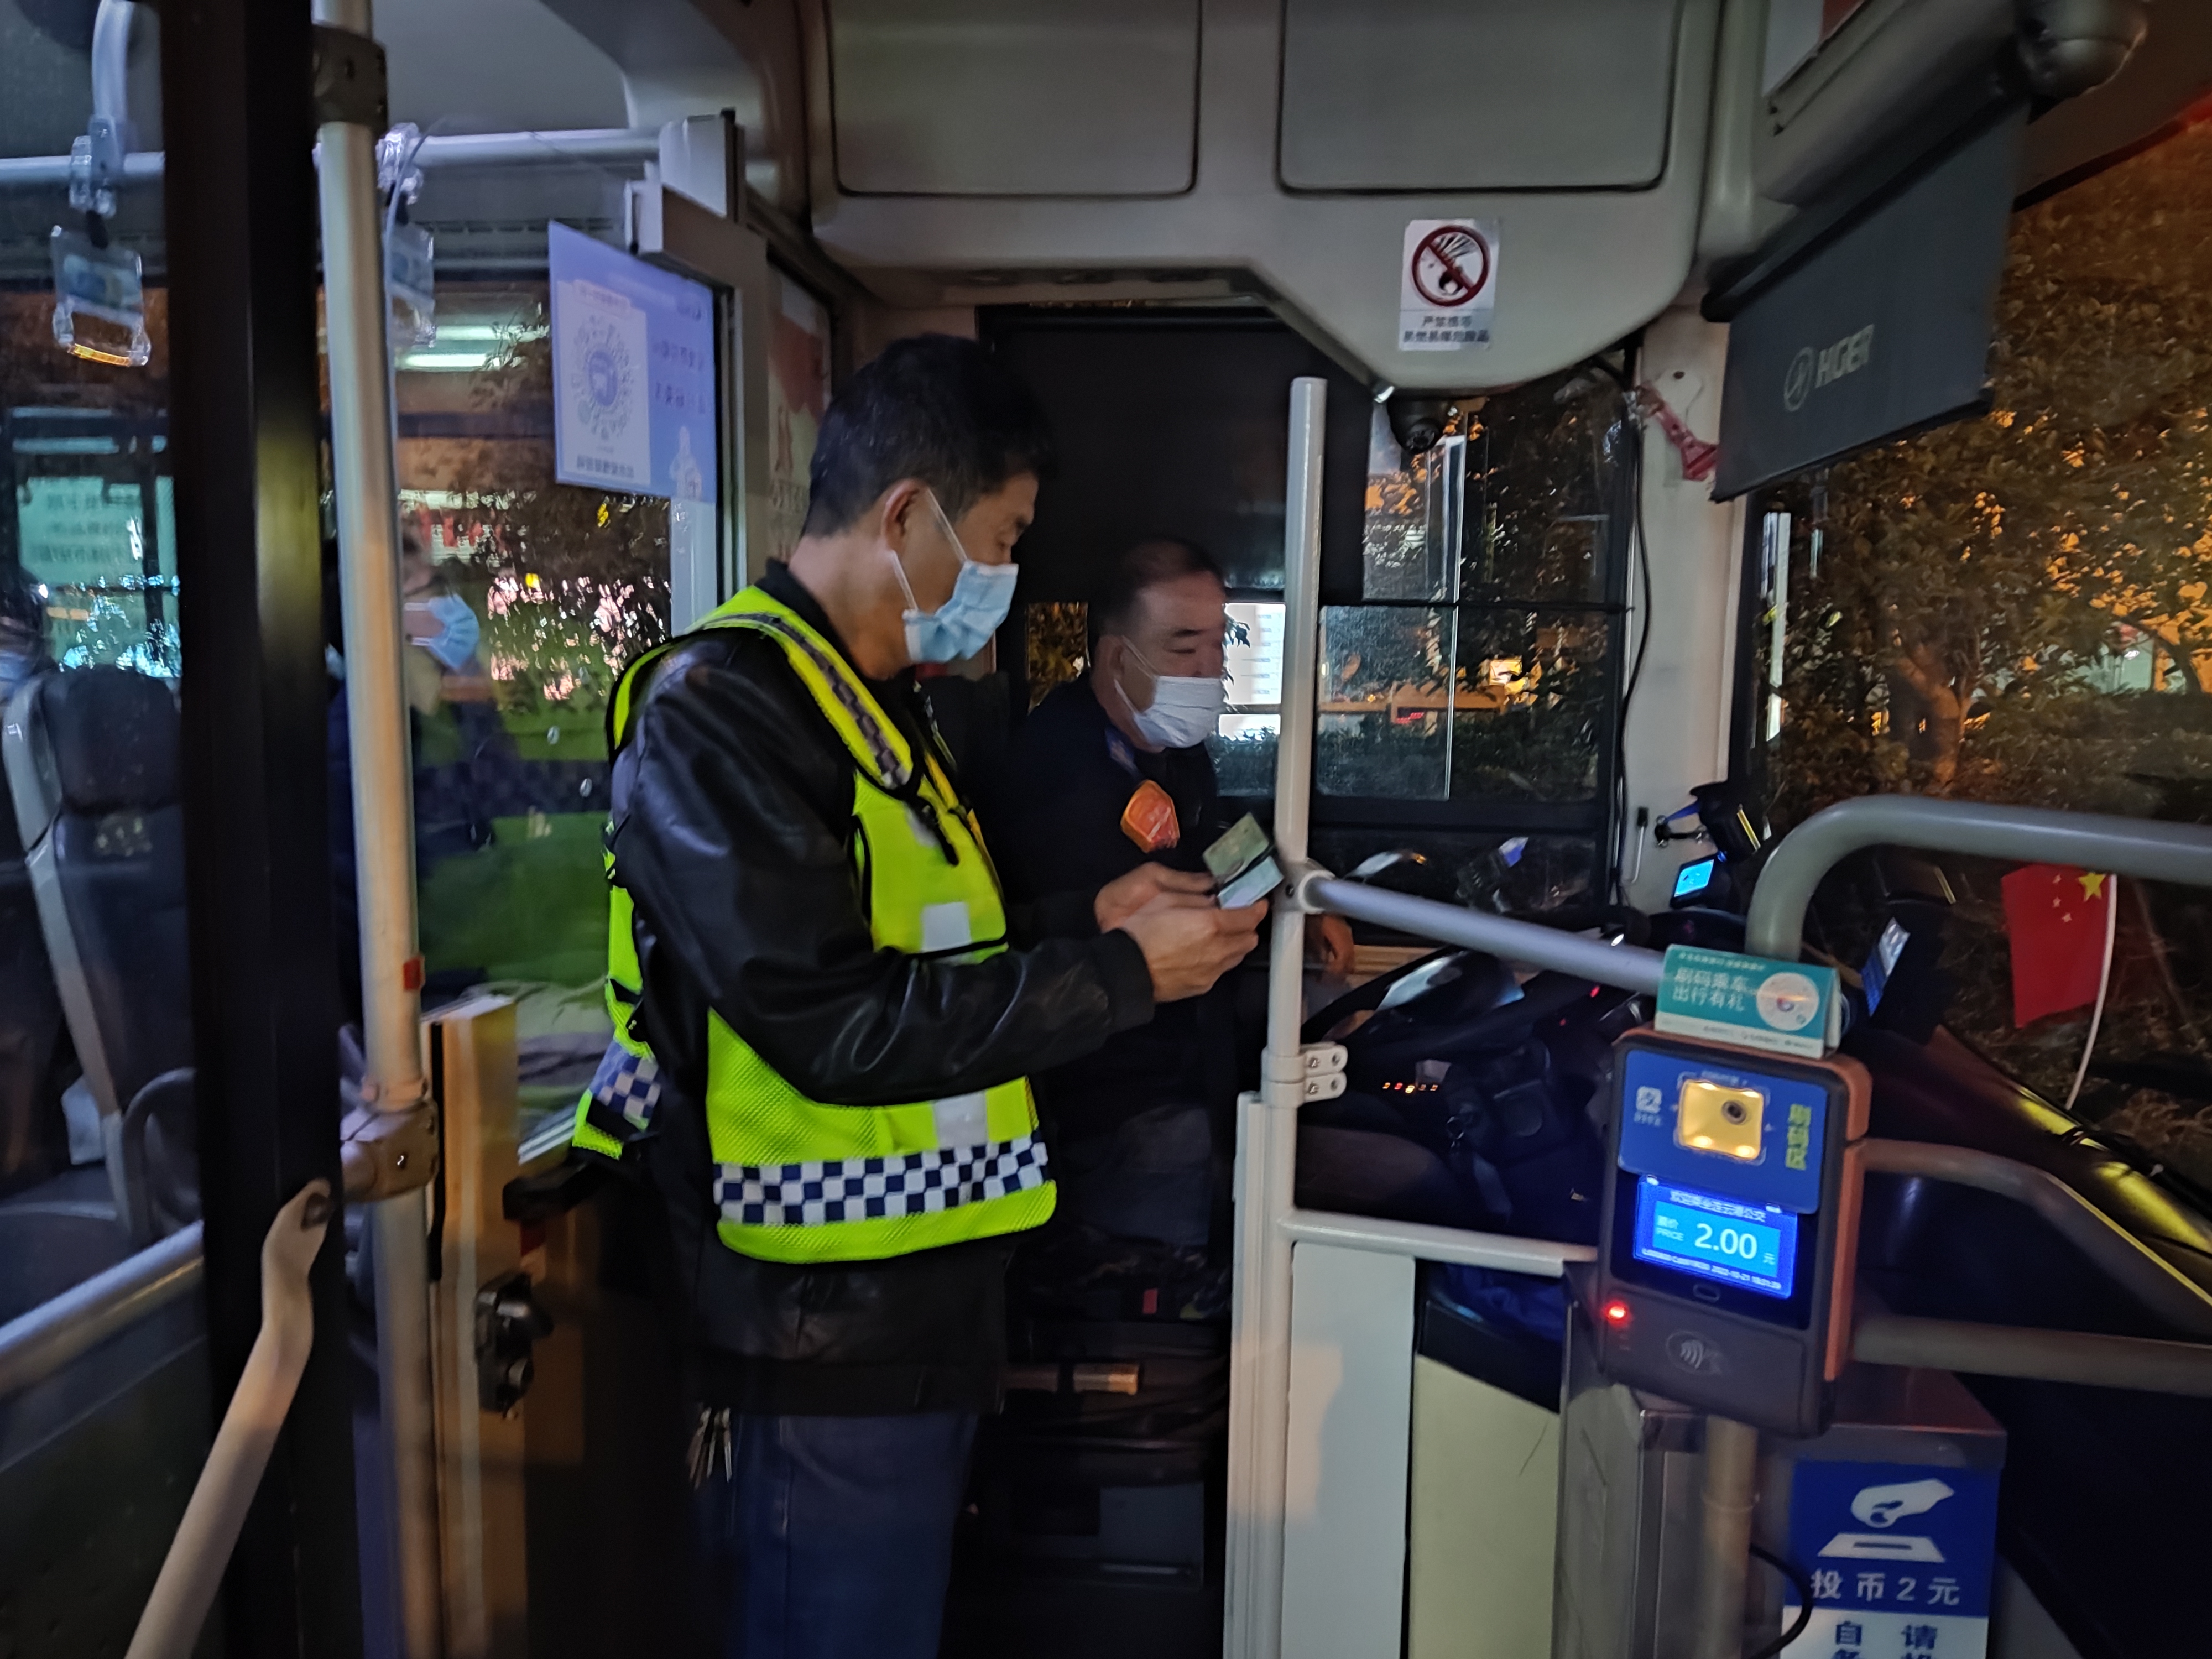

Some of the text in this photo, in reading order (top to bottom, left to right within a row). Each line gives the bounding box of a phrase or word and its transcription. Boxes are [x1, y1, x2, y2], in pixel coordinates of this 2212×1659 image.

[1674, 967, 1750, 993] 刷码乘车
[1673, 985, 1745, 1011] 出行有礼
[1657, 1227, 1684, 1241] PRICE
[1694, 1223, 1757, 1259] 2.00
[1762, 1253, 1775, 1265] 元
